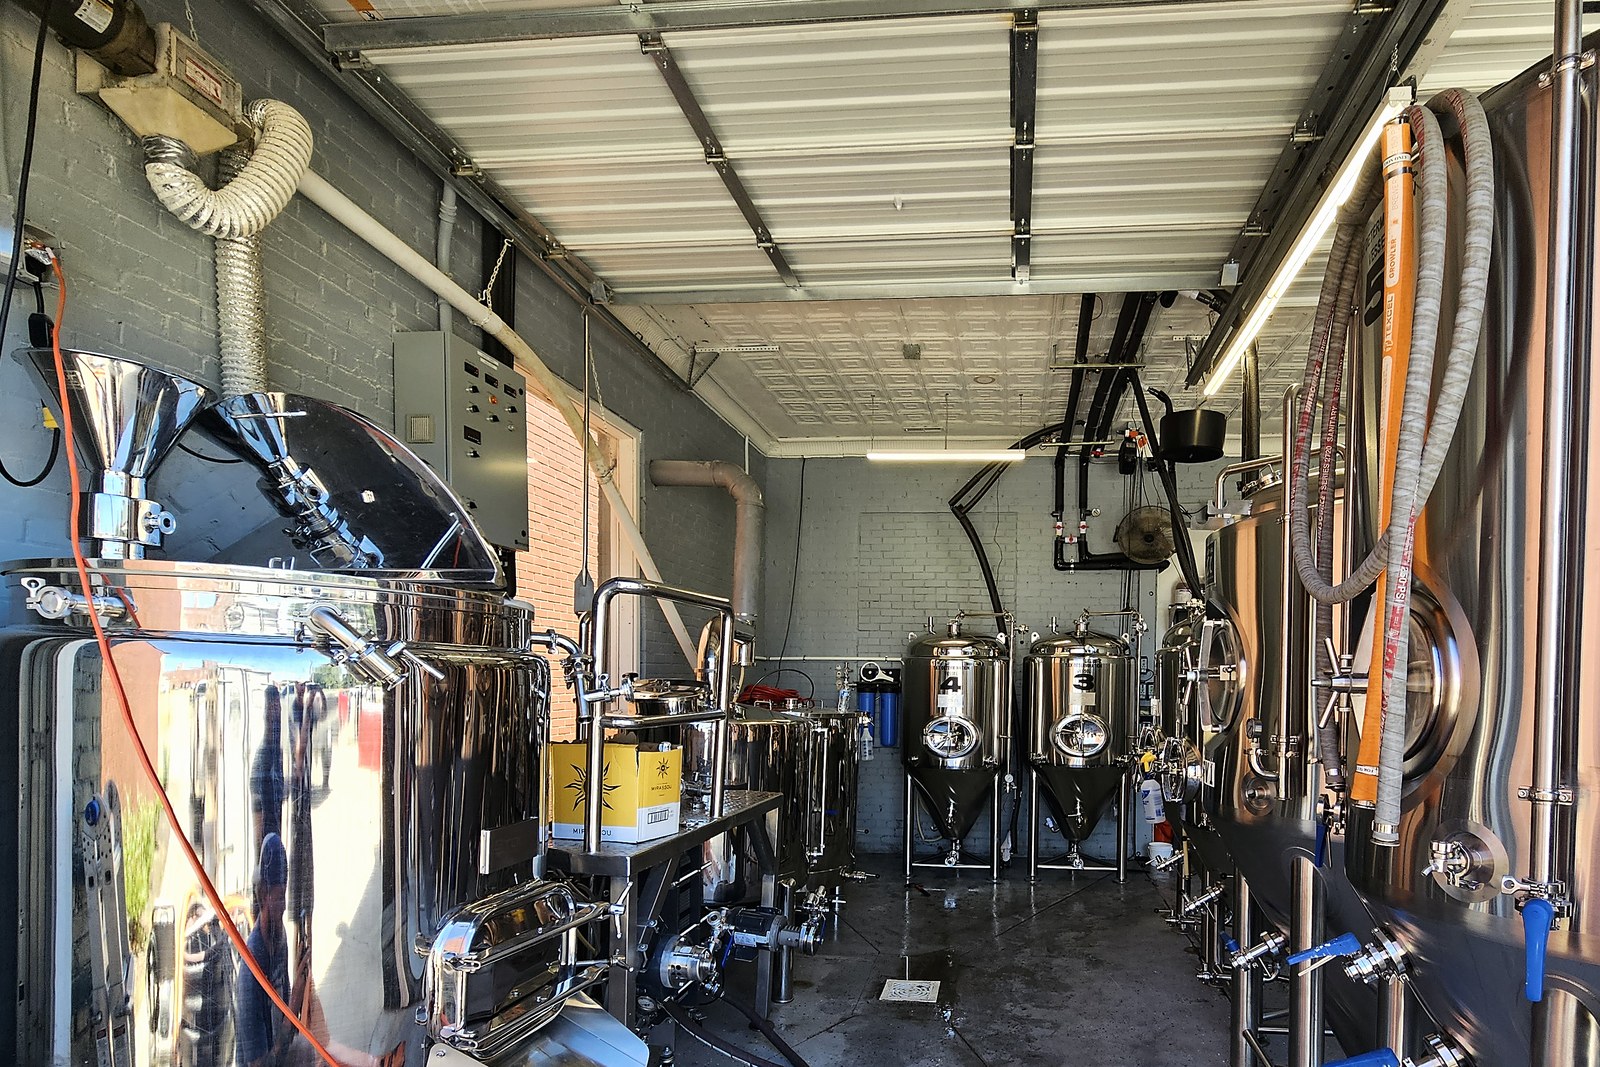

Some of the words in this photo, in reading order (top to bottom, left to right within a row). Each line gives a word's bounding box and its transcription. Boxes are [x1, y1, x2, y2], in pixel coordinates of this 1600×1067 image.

[1388, 238, 1397, 279] GROWLER
[1326, 405, 1338, 442] SANITARY
[1324, 445, 1333, 463] 2720
[940, 677, 961, 692] 4
[1073, 673, 1094, 690] 3
